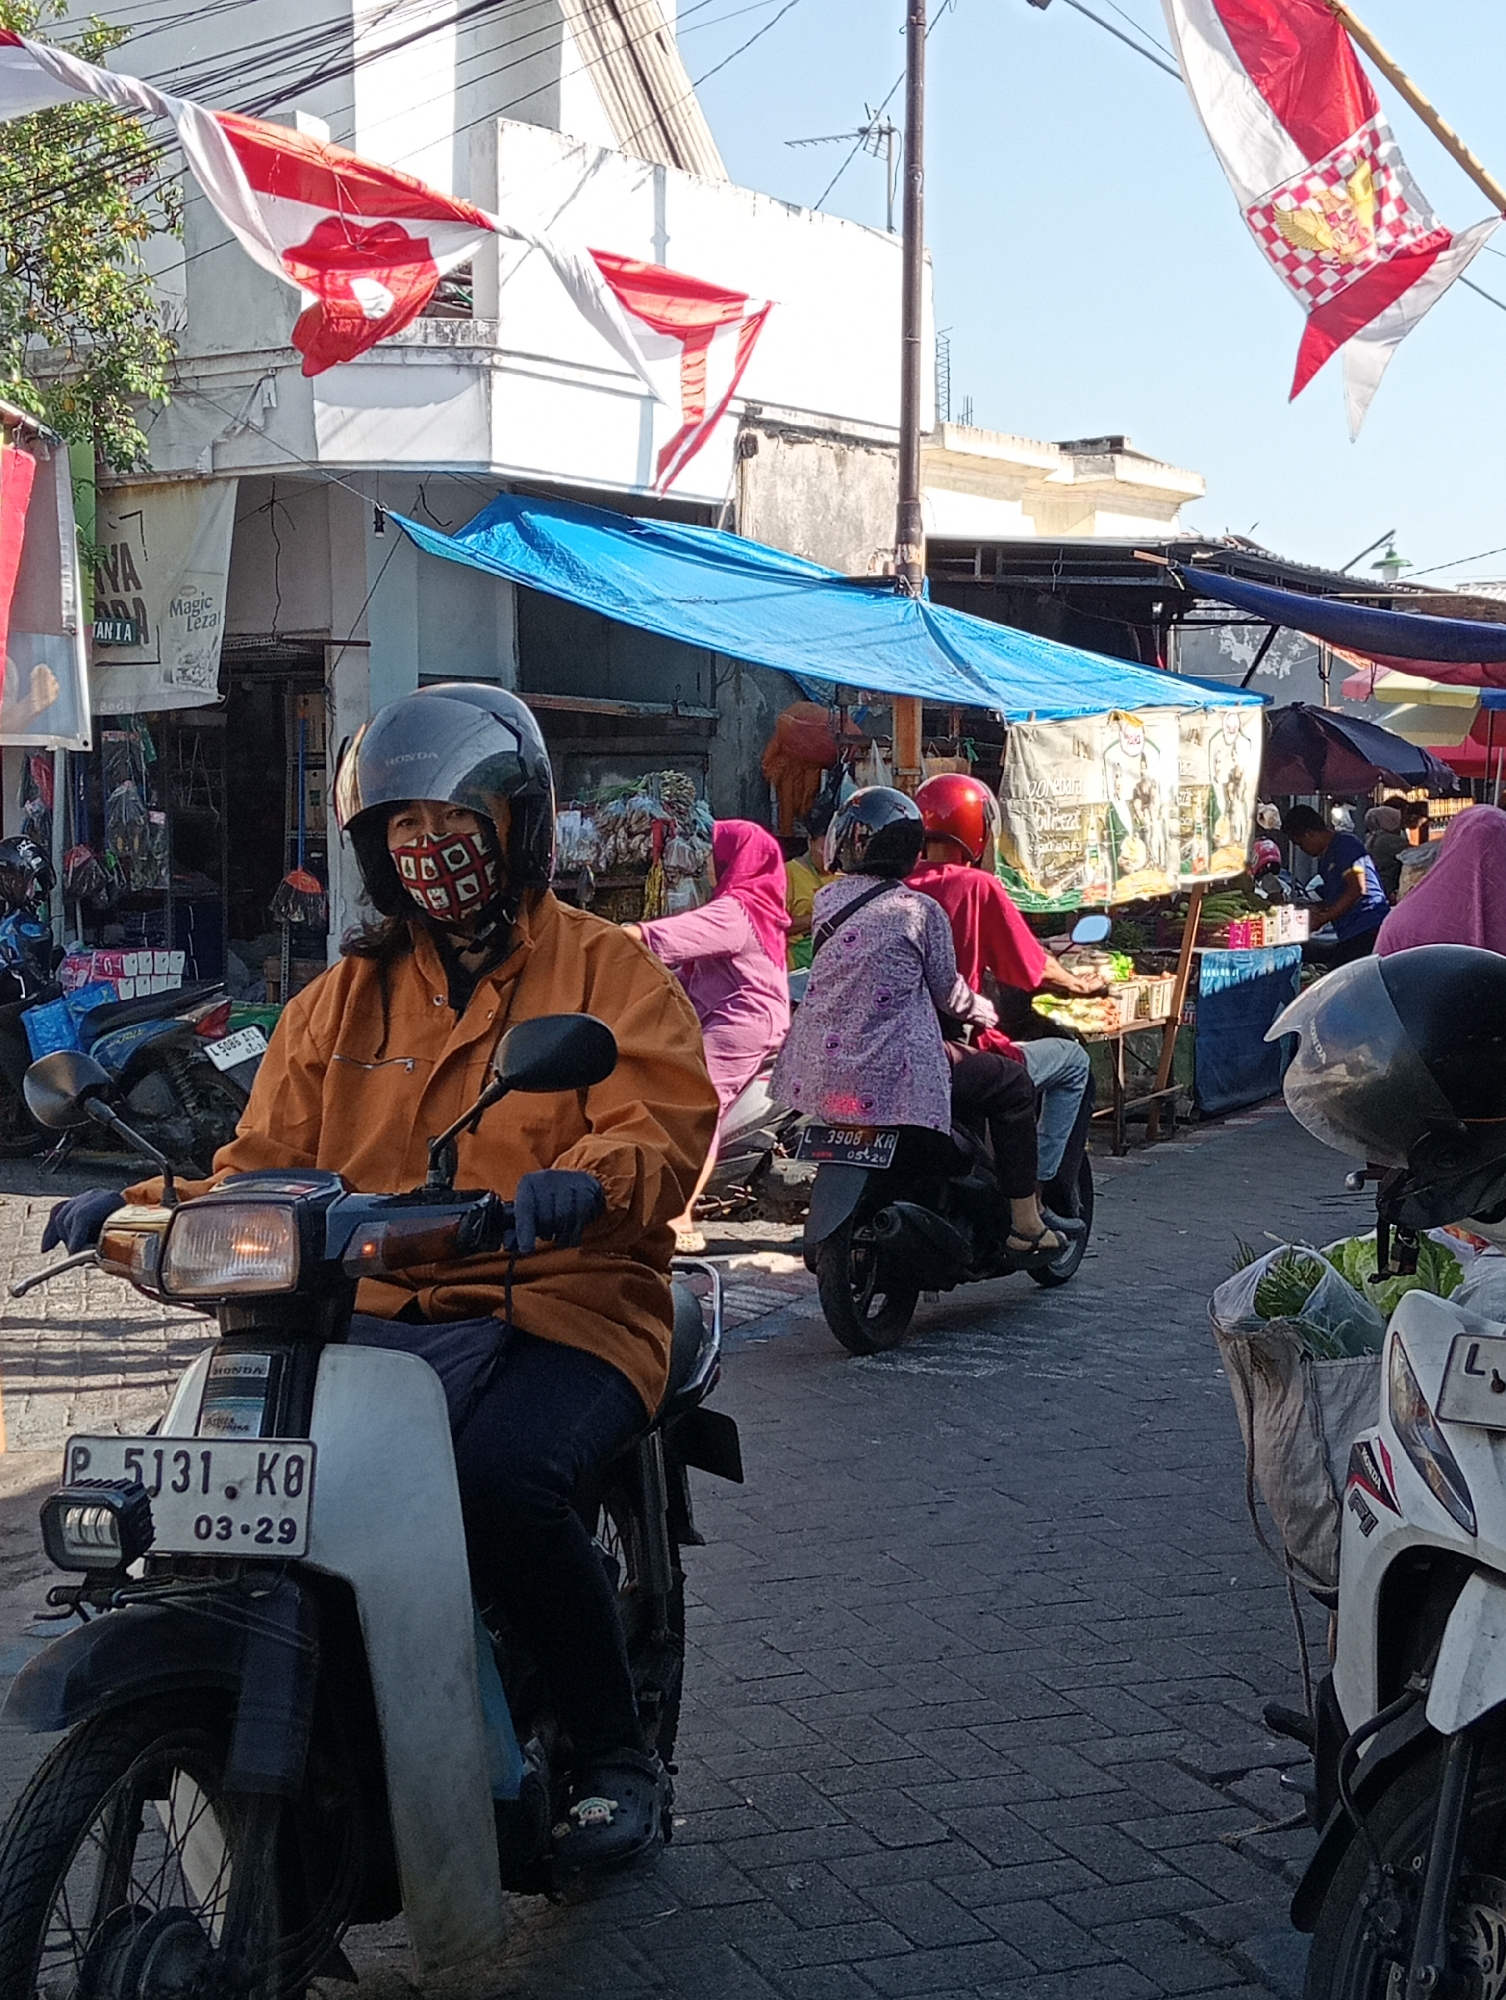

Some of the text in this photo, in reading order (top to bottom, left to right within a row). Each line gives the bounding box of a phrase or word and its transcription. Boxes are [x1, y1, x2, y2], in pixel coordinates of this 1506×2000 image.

[170, 591, 213, 618] Magic
[384, 751, 439, 767] HONDA
[209, 1047, 220, 1057] L
[804, 1128, 895, 1149] L 3908 KR
[212, 1365, 263, 1375] HONDA
[1464, 1343, 1486, 1376] L
[71, 1446, 91, 1484] P
